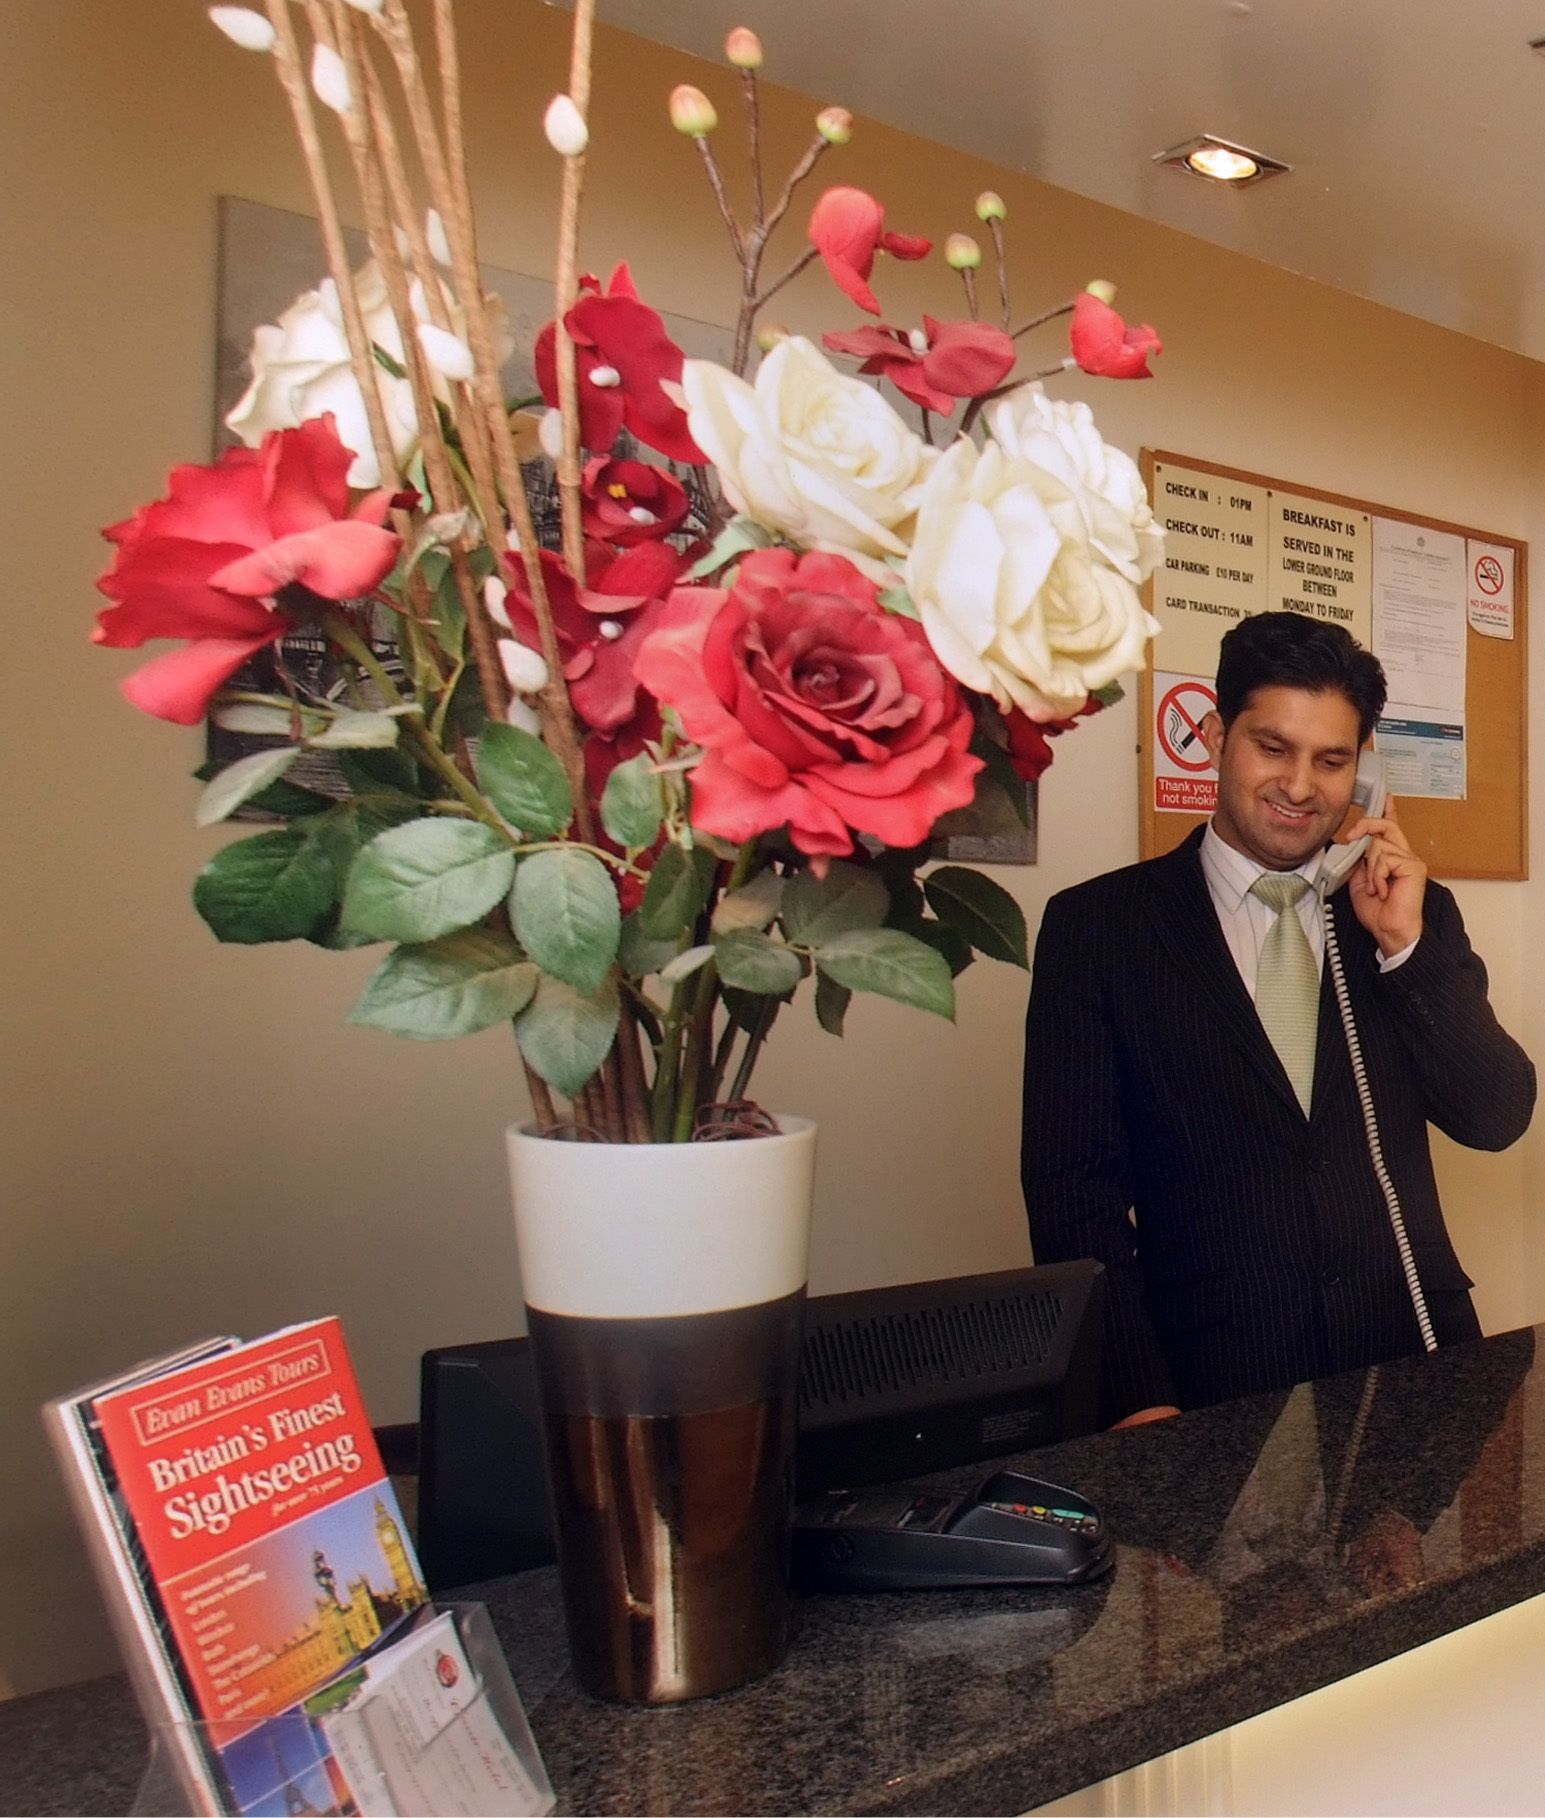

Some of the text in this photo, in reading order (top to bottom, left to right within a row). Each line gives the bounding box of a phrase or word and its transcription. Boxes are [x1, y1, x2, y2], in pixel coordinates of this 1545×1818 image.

[1166, 482, 1197, 499] CHECK
[1199, 489, 1208, 502] IN
[1230, 496, 1252, 511] 01PM
[1166, 518, 1199, 536] CHECK
[1201, 526, 1220, 540] OUT
[1231, 532, 1253, 546] 11AM
[1283, 508, 1356, 537] BREAKFAST IS
[1283, 536, 1355, 563] SERVED IN THE
[1165, 558, 1179, 570] CAR
[1181, 560, 1210, 576] PARKING
[1229, 569, 1241, 582] PER
[1282, 556, 1354, 583] LOWER GROUND FLOOR
[1303, 579, 1337, 597] BETWEEN
[1166, 596, 1187, 609] CARD
[1188, 600, 1240, 619] TRANSACTION
[1282, 597, 1354, 621] MONDAY TO FRIDAY
[1158, 778, 1191, 793] Thank
[1193, 783, 1213, 796] you
[1163, 793, 1218, 806] not smokin
[146, 1352, 319, 1434] Evan Evans Tours
[147, 1392, 347, 1493] Britain's Finest
[164, 1434, 362, 1539] Sightseeing
